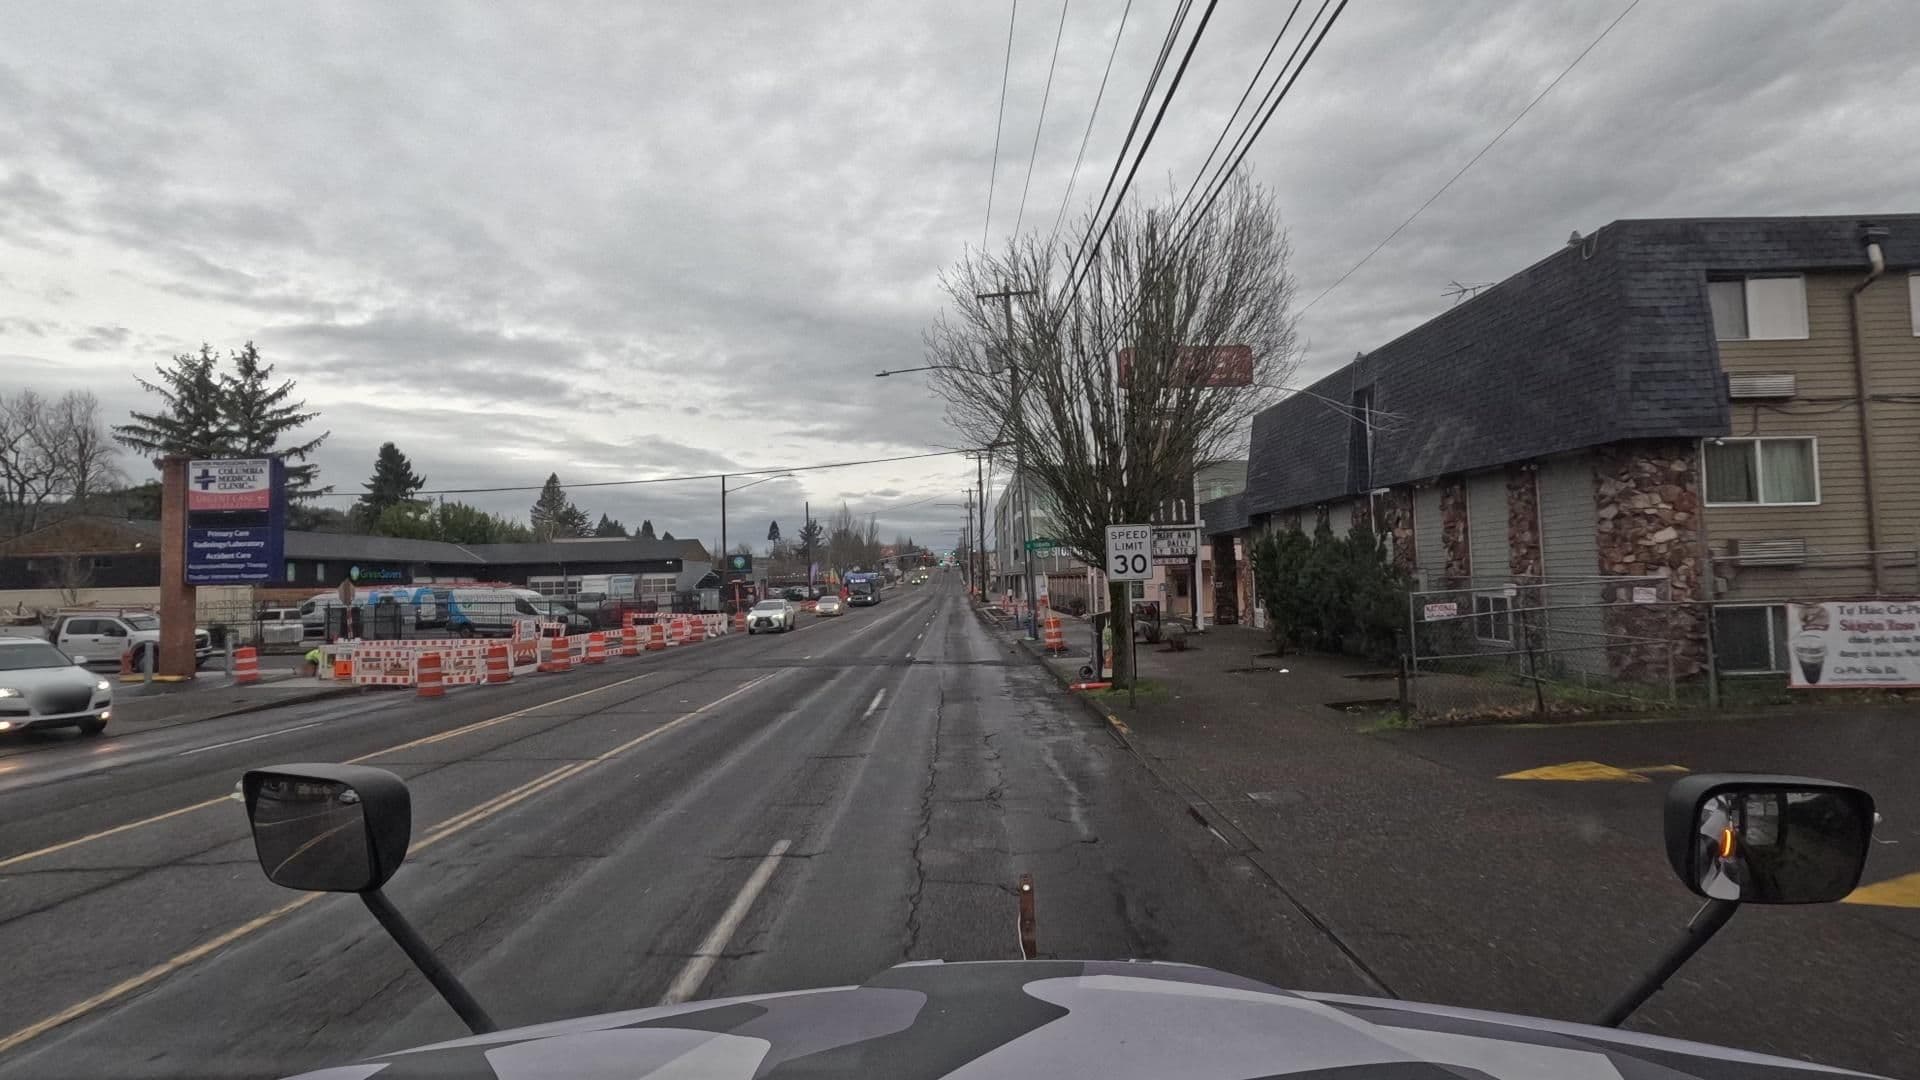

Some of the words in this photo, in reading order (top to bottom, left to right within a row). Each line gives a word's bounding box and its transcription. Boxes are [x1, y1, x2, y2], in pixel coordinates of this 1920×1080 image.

[217, 467, 264, 475] COLUMBIA
[217, 482, 248, 490] CLINIC
[1111, 530, 1148, 540] SPEED
[1114, 541, 1144, 551] LIMIT
[1113, 553, 1147, 574] 30
